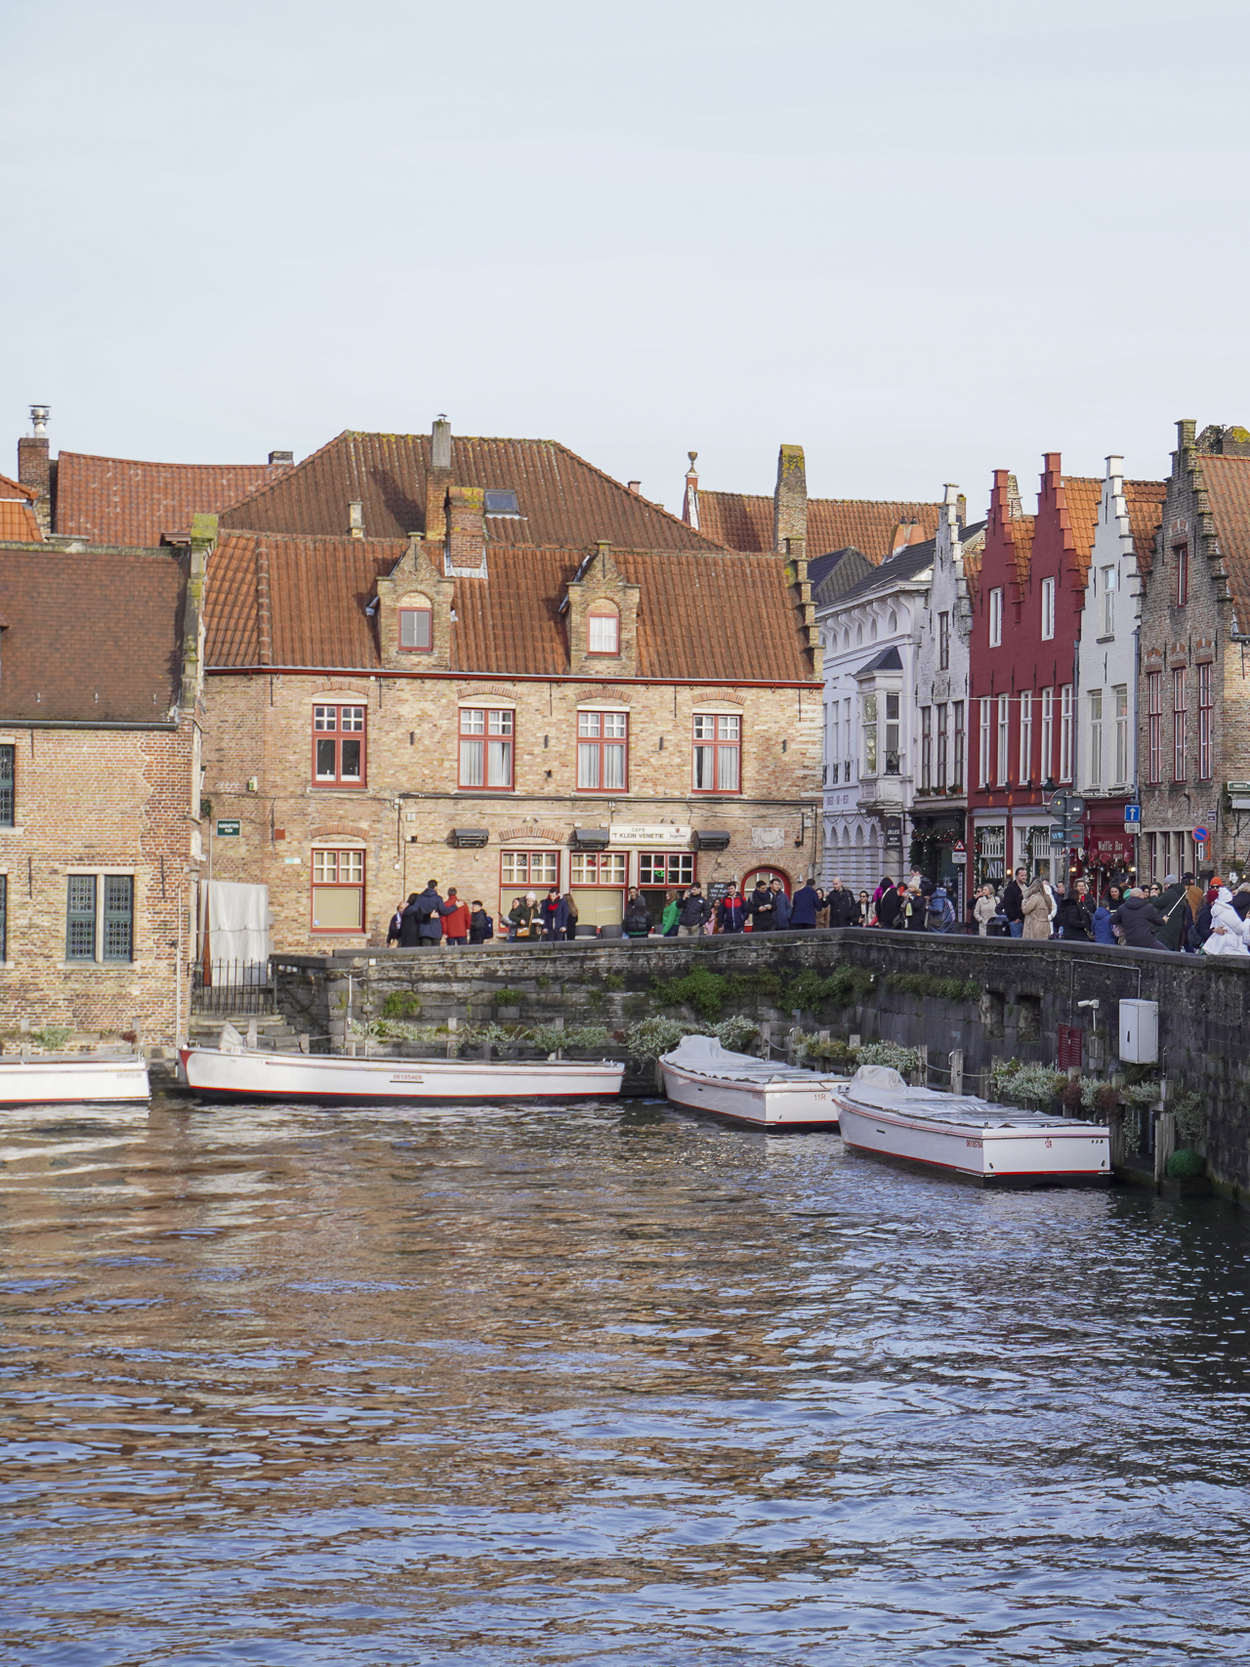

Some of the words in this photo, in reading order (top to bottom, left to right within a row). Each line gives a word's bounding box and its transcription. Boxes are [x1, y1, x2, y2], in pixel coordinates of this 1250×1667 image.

[1098, 841, 1113, 851] Waffle
[1114, 841, 1123, 851] Bar
[813, 1093, 826, 1101] 11R
